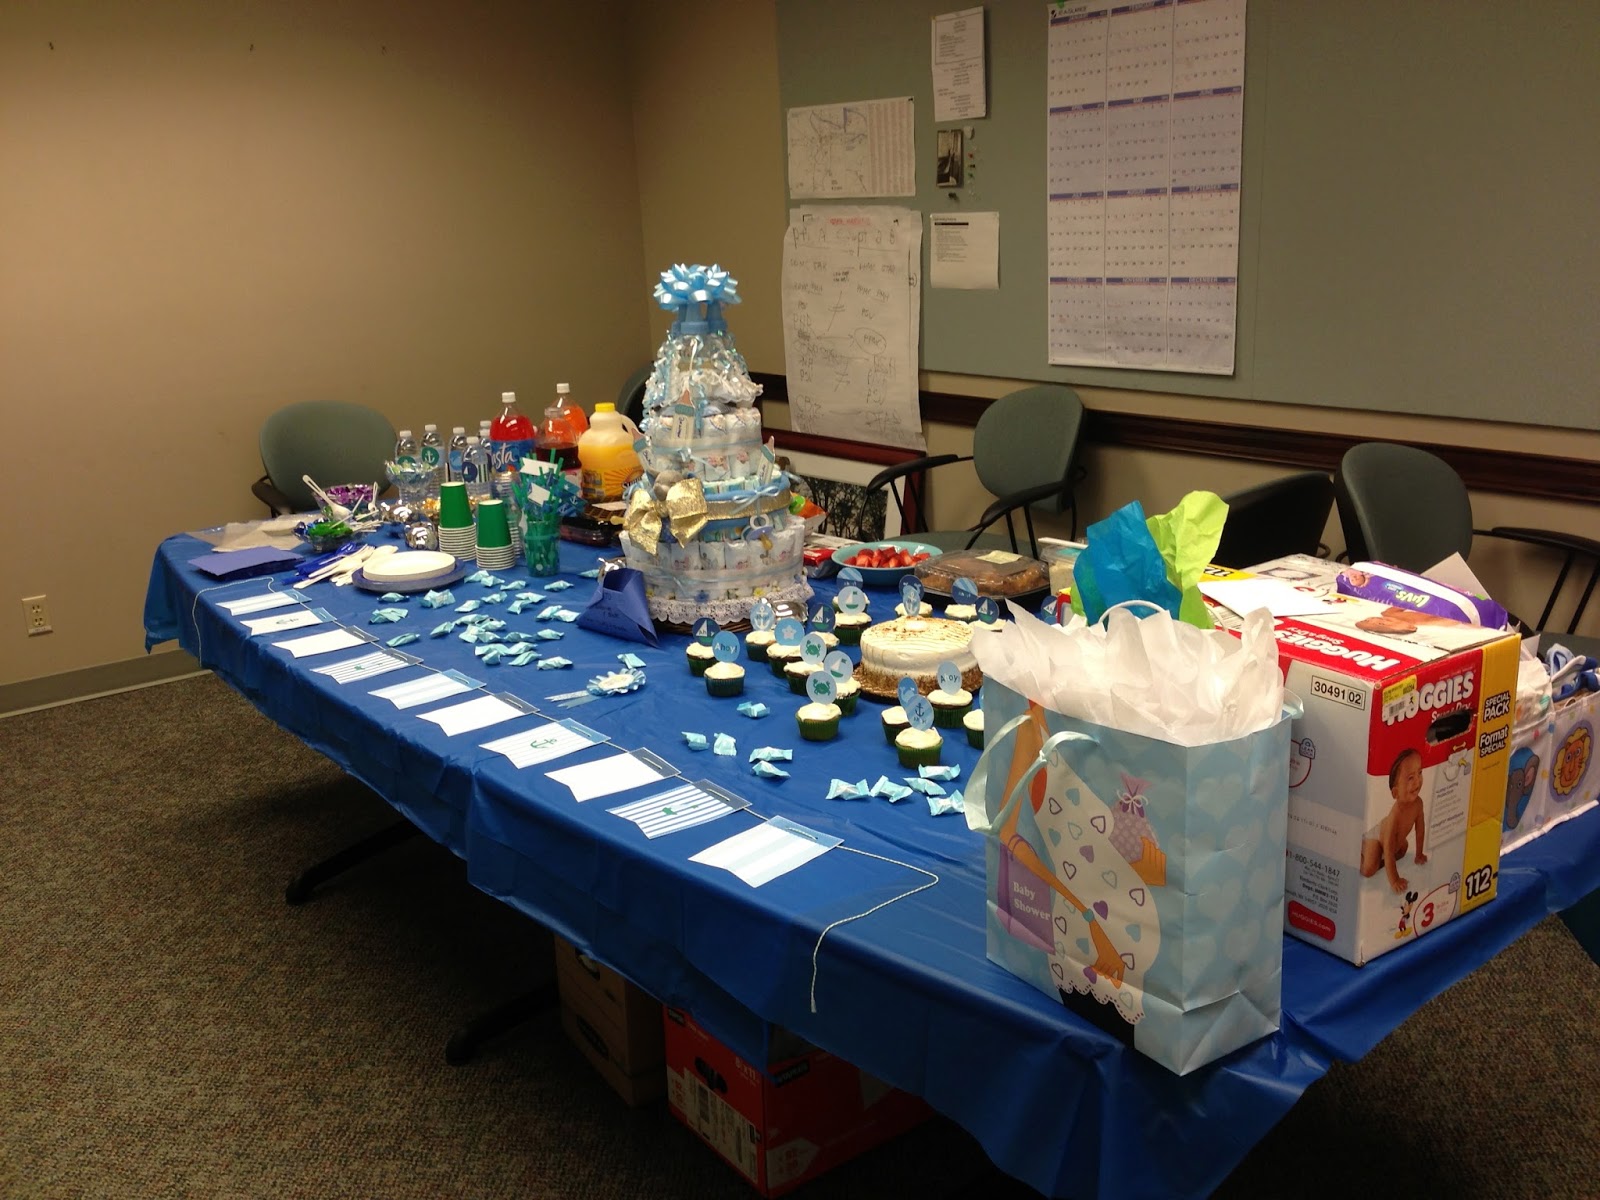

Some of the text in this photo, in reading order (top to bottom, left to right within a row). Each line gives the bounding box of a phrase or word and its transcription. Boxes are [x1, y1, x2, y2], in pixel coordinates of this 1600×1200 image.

[491, 442, 518, 469] asta
[1395, 590, 1431, 608] Luvs
[714, 642, 738, 654] Ahoy!
[1274, 630, 1400, 671] HUGGIES
[1382, 671, 1475, 726] UGGIES
[1485, 690, 1510, 708] SPECIAL
[1484, 700, 1510, 722] PACK
[1480, 725, 1508, 747] Format
[1481, 740, 1505, 757] SPECIAL
[1013, 881, 1035, 900] Baby
[1466, 865, 1492, 899] 112
[1014, 899, 1050, 920] Shower
[1421, 902, 1434, 927] 3
